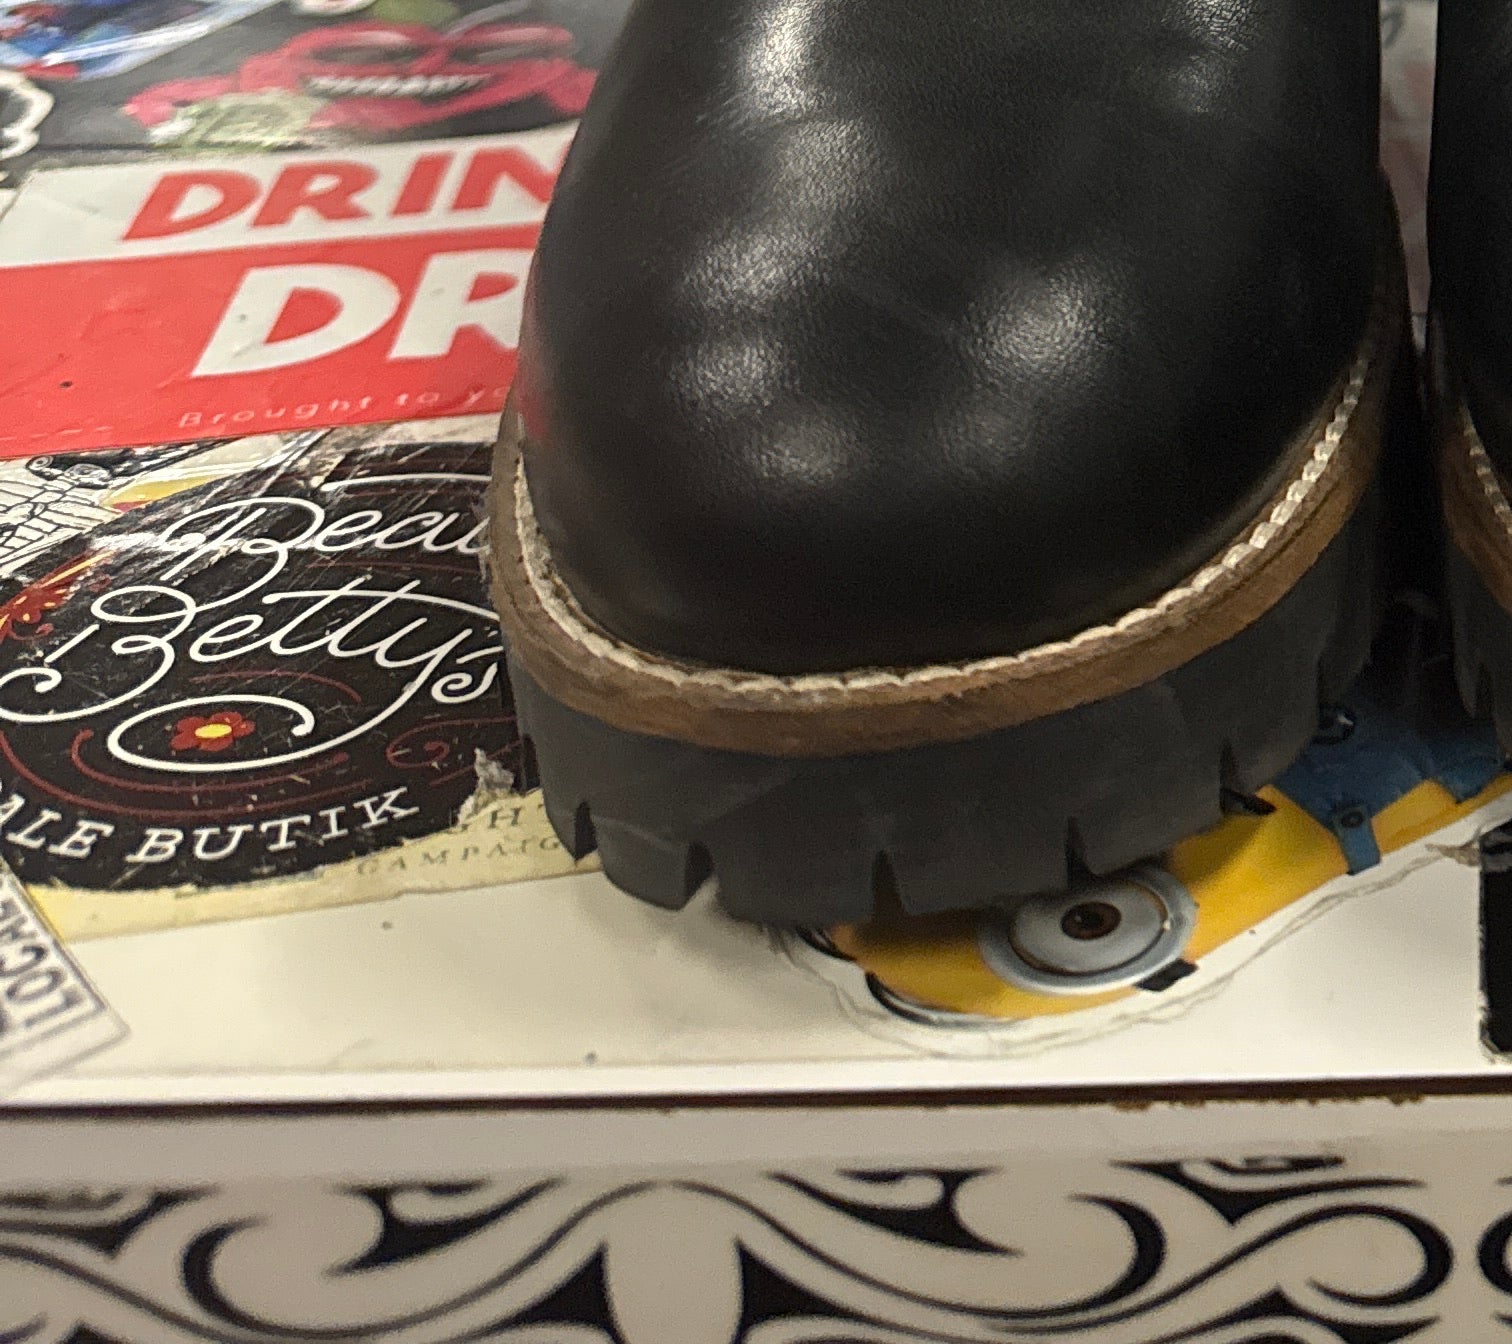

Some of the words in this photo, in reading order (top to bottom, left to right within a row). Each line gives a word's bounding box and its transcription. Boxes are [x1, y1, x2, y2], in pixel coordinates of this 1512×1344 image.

[122, 146, 570, 240] DRIN
[190, 248, 534, 377] DR
[178, 395, 373, 429] Brought
[394, 392, 441, 408] to
[125, 786, 419, 863] BUTIK
